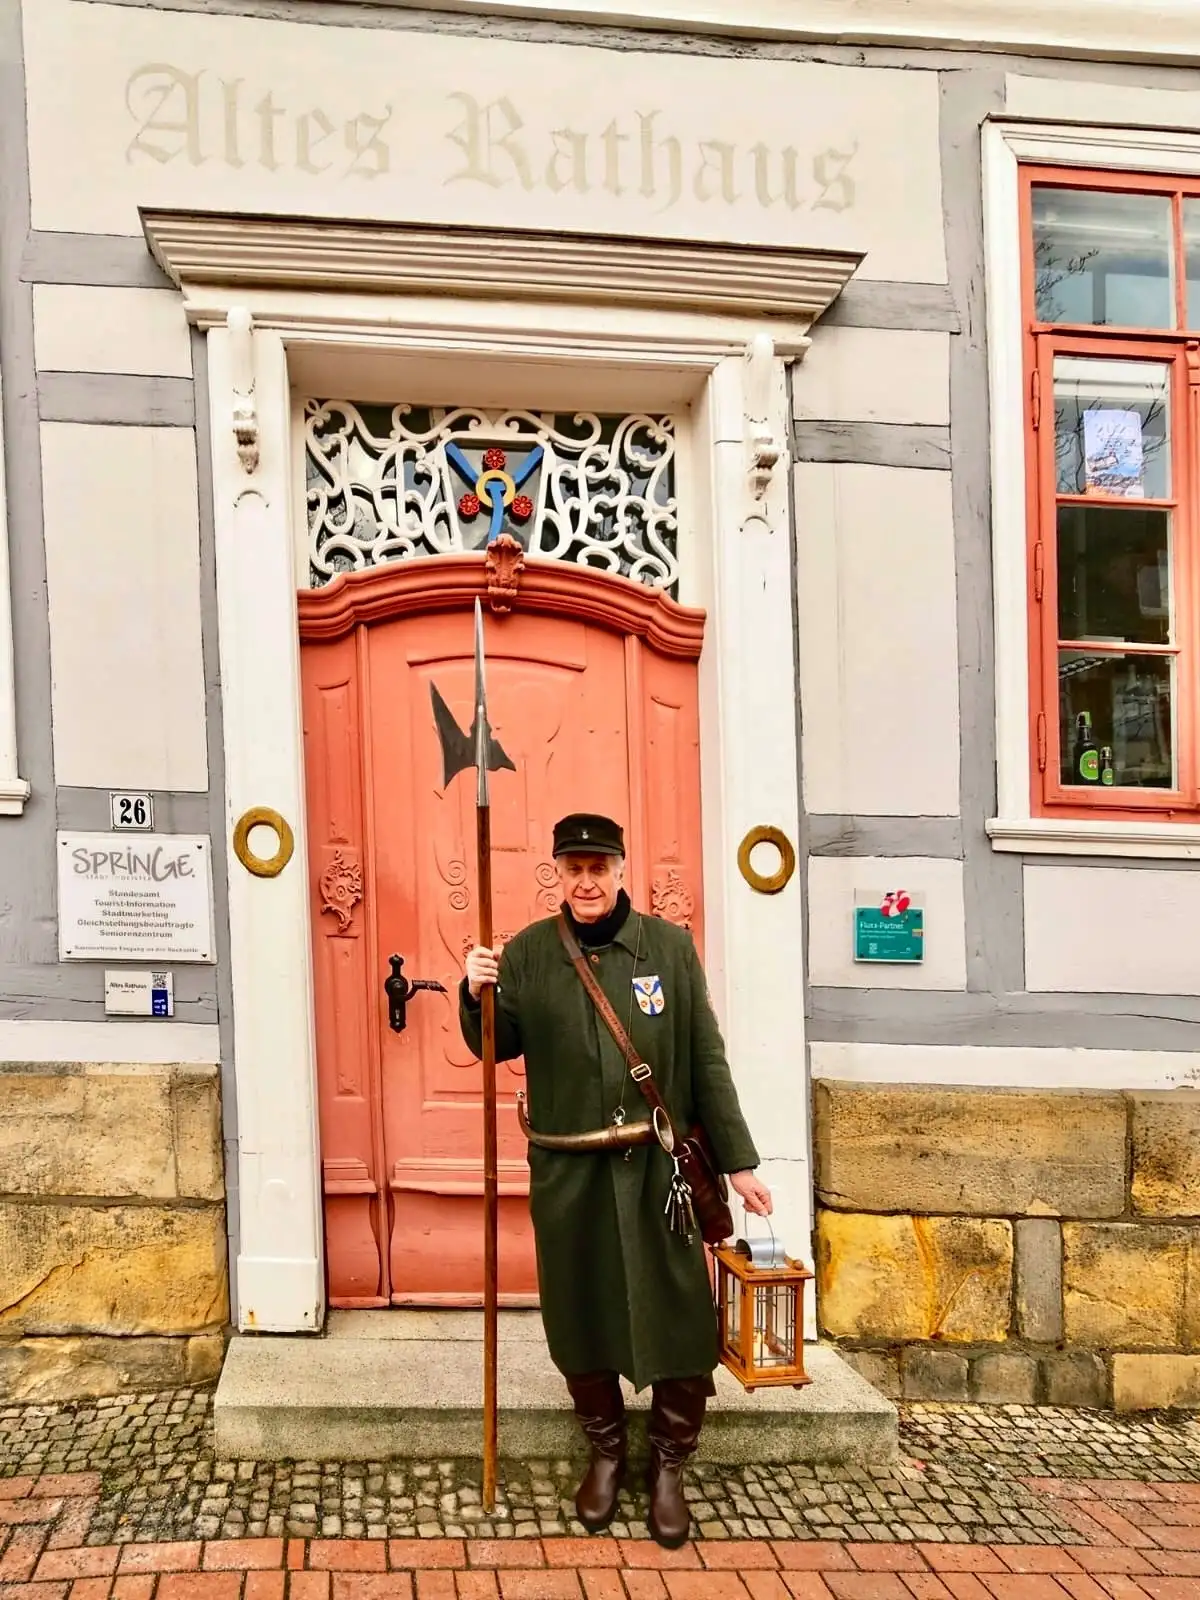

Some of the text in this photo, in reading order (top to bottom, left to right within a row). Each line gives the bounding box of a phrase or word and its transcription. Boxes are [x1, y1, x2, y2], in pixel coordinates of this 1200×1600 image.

[124, 62, 861, 215] Altes Rathaus
[119, 798, 146, 825] 26
[108, 890, 160, 898] Standesamt
[94, 899, 176, 909] Tourist-Information
[102, 910, 169, 919] Stadtmarketing
[77, 919, 195, 930] Gleichstellungsbeauftragte
[100, 930, 173, 939] Seniorenzentrum
